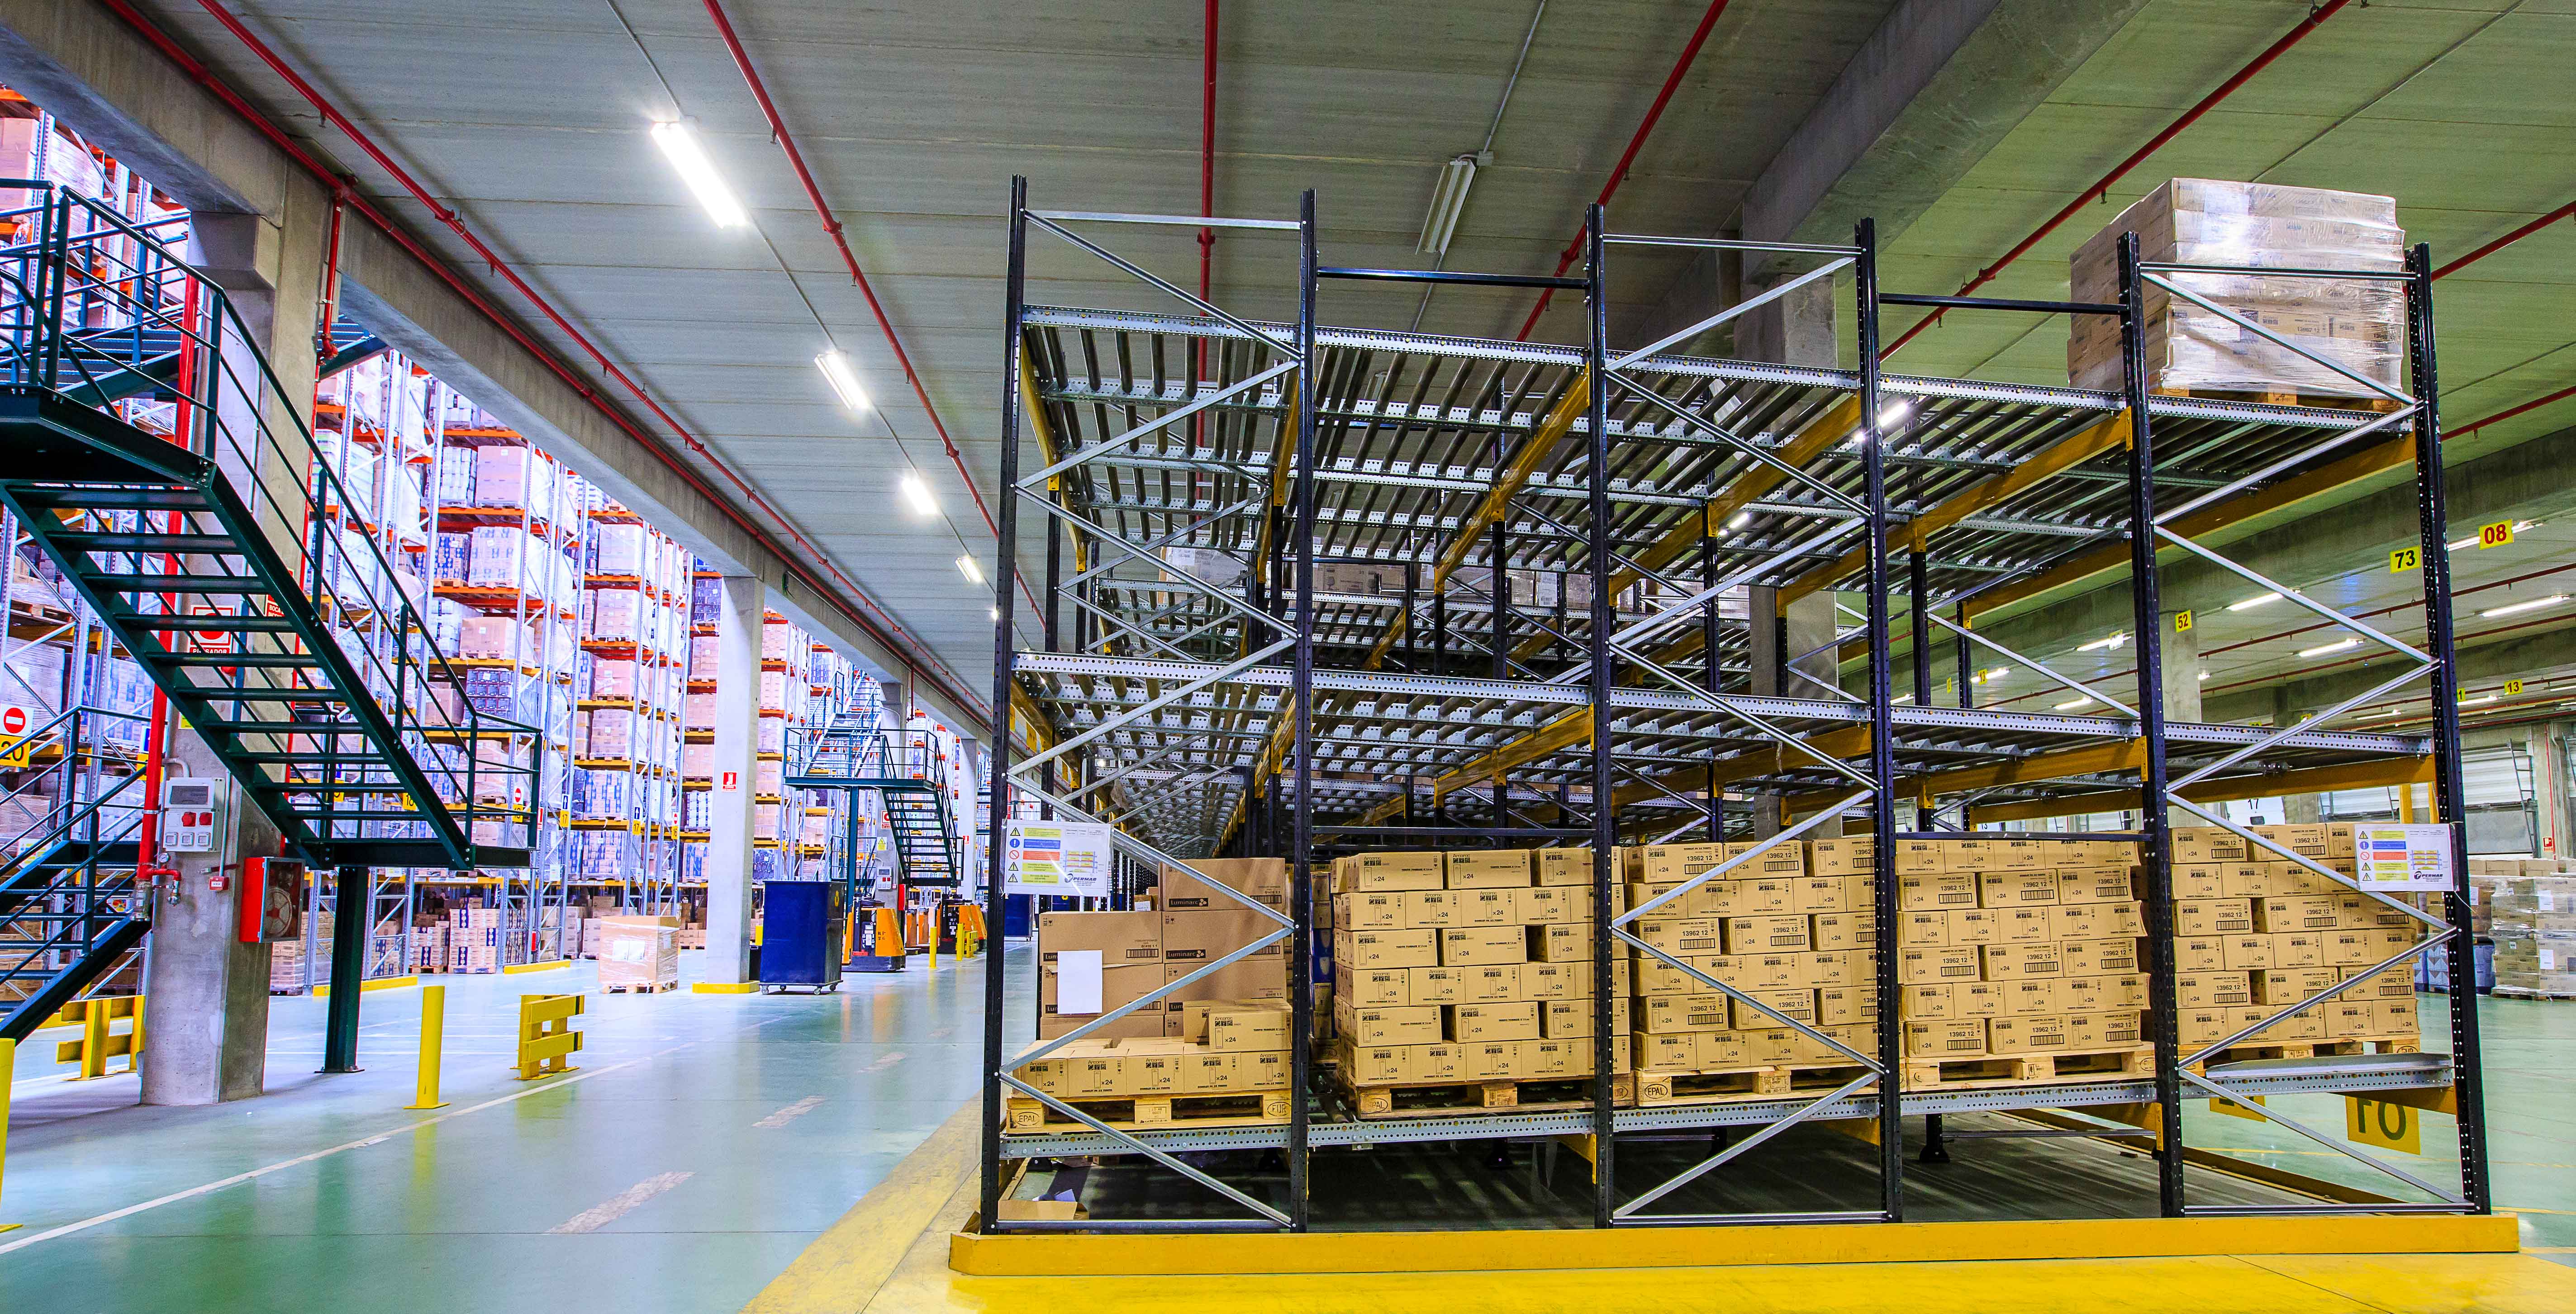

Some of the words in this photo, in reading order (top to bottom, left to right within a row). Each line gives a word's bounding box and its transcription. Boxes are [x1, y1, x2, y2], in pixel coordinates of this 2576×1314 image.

[2484, 524, 2507, 544] 08
[2395, 550, 2415, 569] 73
[2178, 614, 2188, 629] 52
[1979, 672, 1986, 682] 13
[2508, 681, 2519, 693] 13
[2248, 799, 2259, 810] 17
[562, 814, 567, 824] 17
[1648, 1088, 1665, 1096] EPAL
